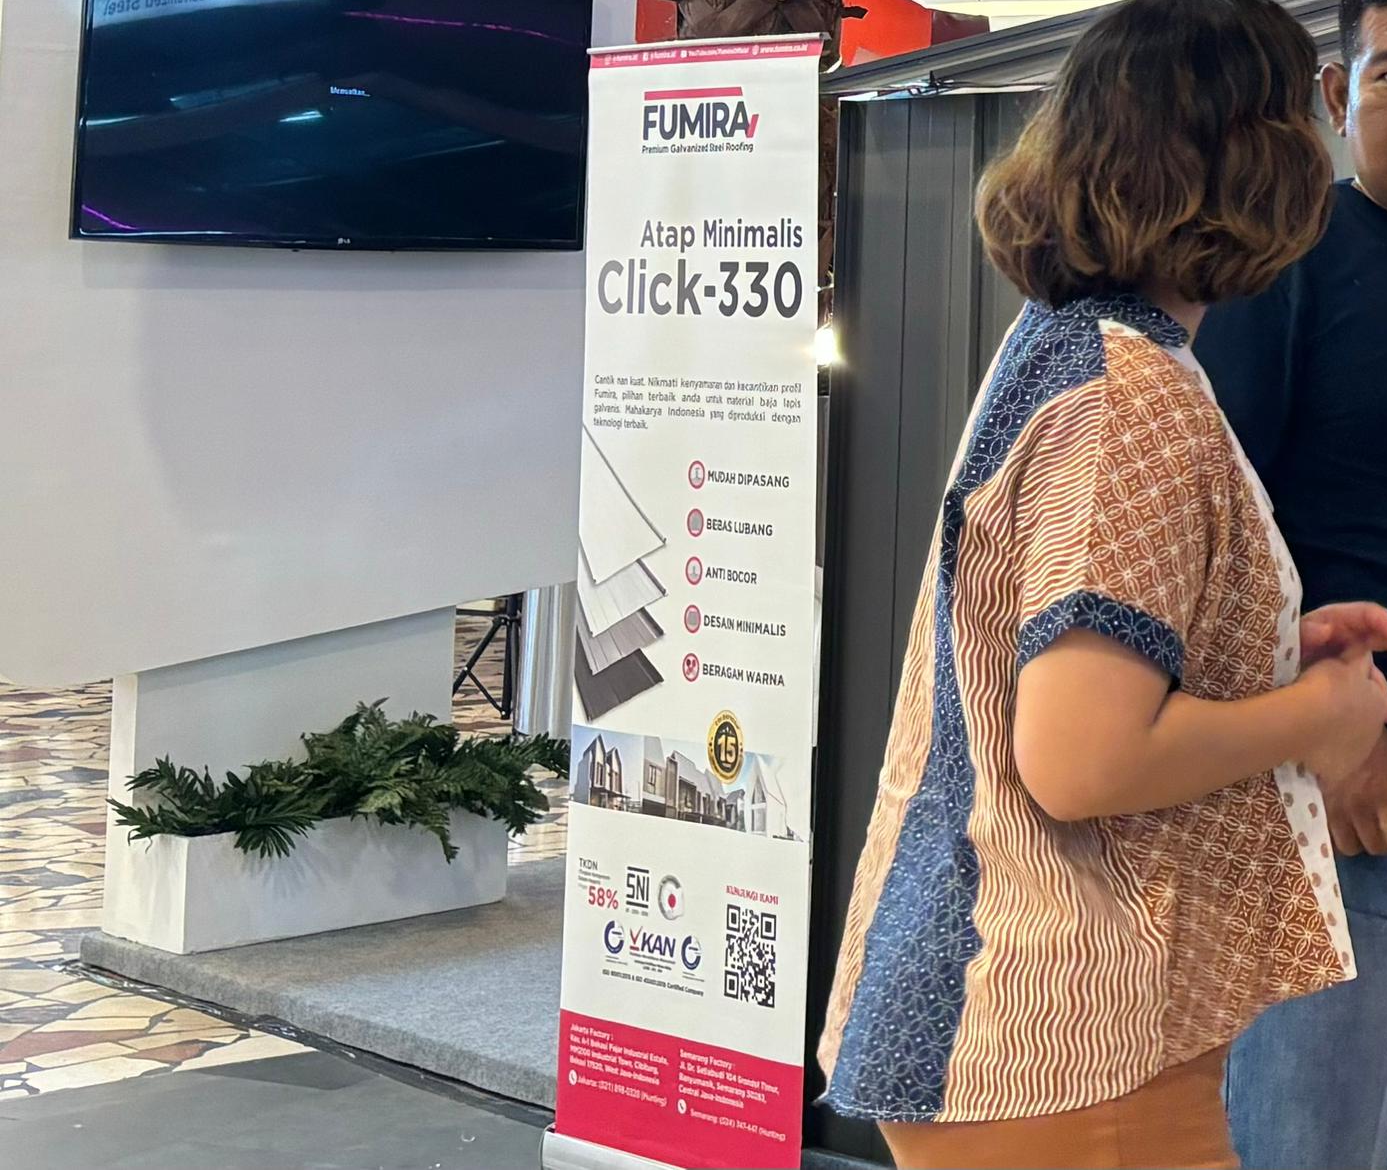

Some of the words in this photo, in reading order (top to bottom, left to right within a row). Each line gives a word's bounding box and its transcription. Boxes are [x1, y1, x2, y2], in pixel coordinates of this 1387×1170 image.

[643, 101, 751, 141] FUMIRA
[641, 145, 669, 154] Premium
[671, 143, 709, 154] Galvanized
[726, 141, 754, 153] Roofing
[640, 219, 695, 254] Atap
[703, 217, 803, 249] Minimalis
[598, 258, 803, 320] Click-330
[648, 392, 676, 402] terbaik
[681, 393, 701, 403] anda
[668, 407, 705, 417] Indonesia
[707, 470, 736, 485] MUDAH
[738, 473, 790, 489] DIPASANG
[706, 517, 733, 533] BEBAS
[734, 521, 774, 537] LUBANG
[705, 566, 726, 581] ANTI
[727, 569, 757, 585] BOCOR
[703, 614, 735, 630] DESAIN
[737, 618, 787, 637] MINIMALIS
[702, 663, 744, 682] BERAGAM
[745, 669, 785, 687] WARNA
[718, 734, 737, 764] 15
[579, 857, 599, 871] TKDN
[588, 885, 619, 910] 58%
[626, 873, 650, 903] SNI
[641, 932, 676, 958] KAN
